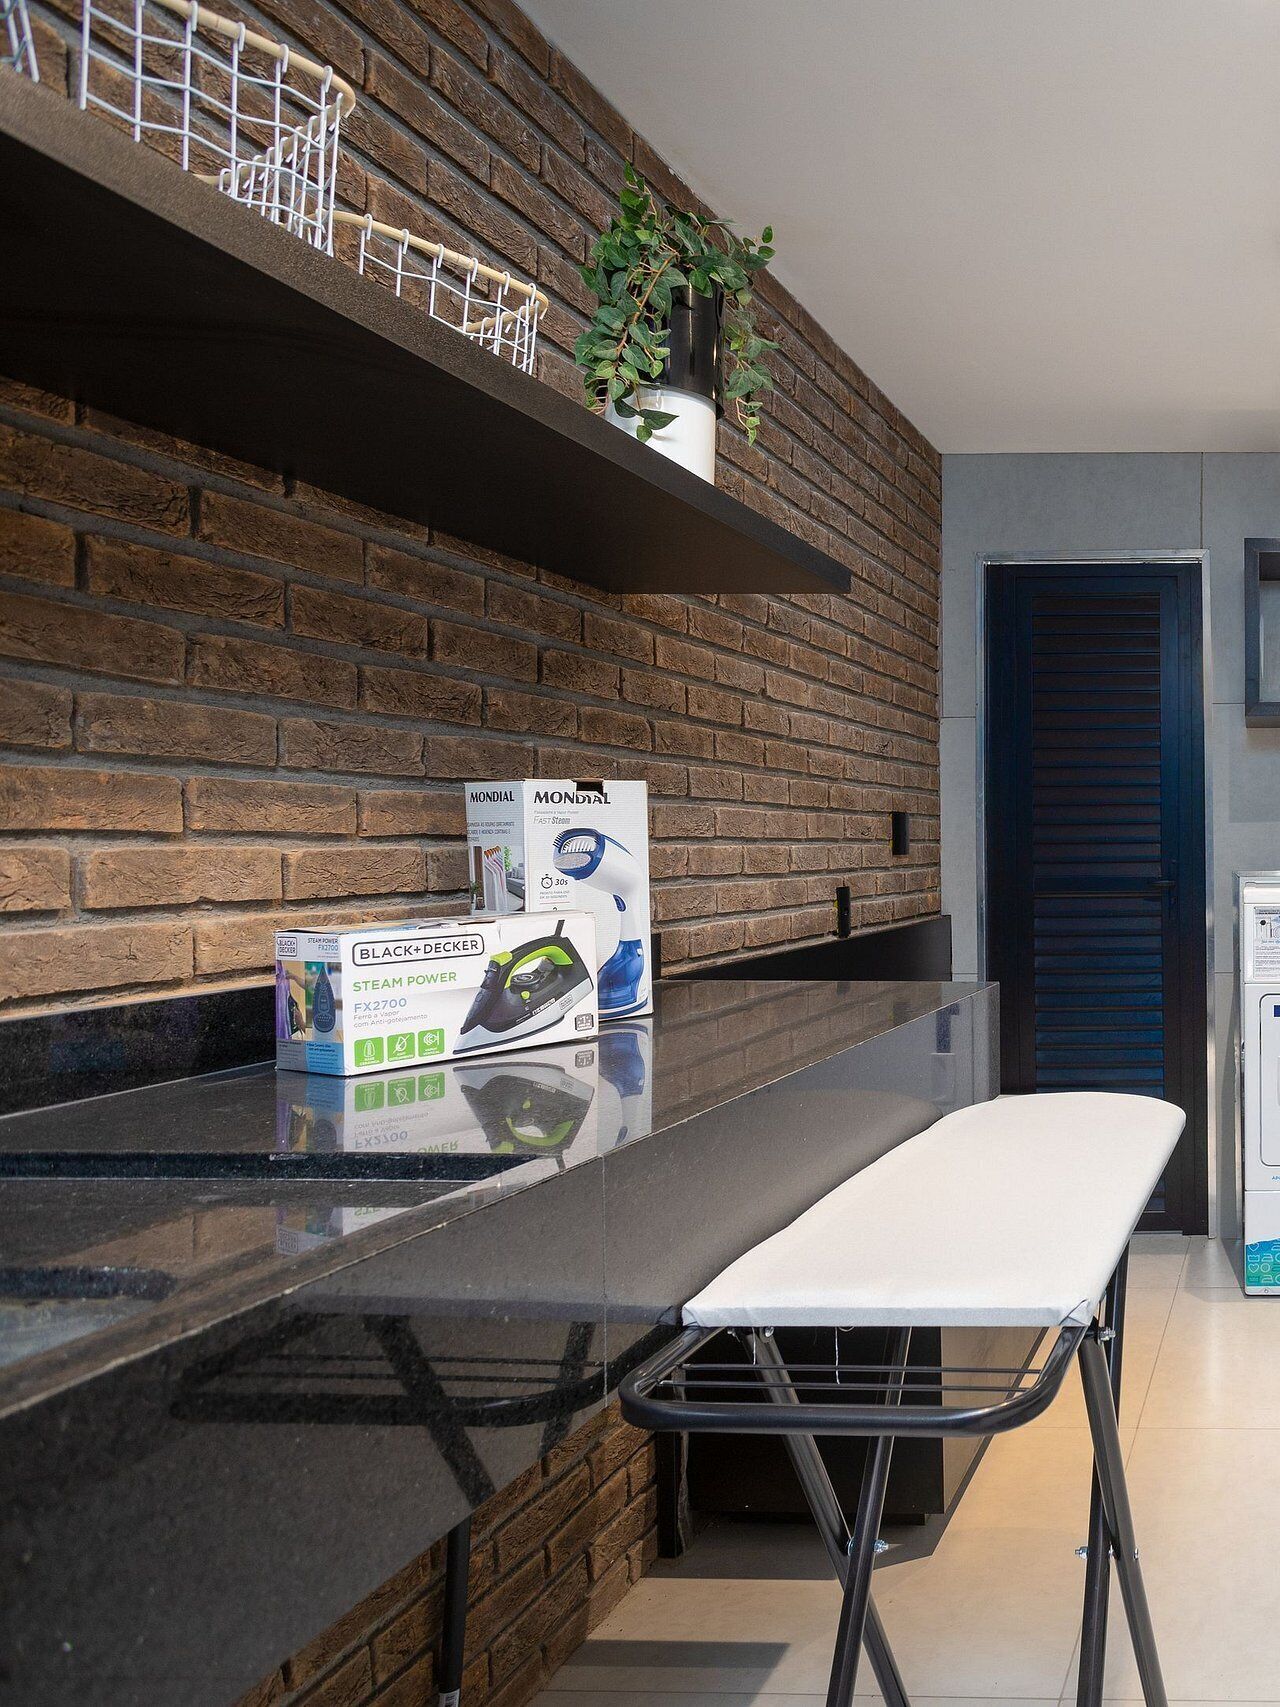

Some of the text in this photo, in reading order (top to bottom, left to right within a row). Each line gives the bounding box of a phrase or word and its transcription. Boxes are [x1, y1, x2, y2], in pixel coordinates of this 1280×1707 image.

[470, 791, 514, 802] MONDIAL
[552, 816, 571, 825] Steam
[360, 940, 479, 960] BLACK+DECKER
[353, 972, 457, 992] STEAM POWER
[354, 998, 407, 1013] FX2700
[354, 1012, 371, 1020] Ferro
[380, 1010, 399, 1019] Vapor
[371, 1014, 428, 1026] Anti-gotejamento
